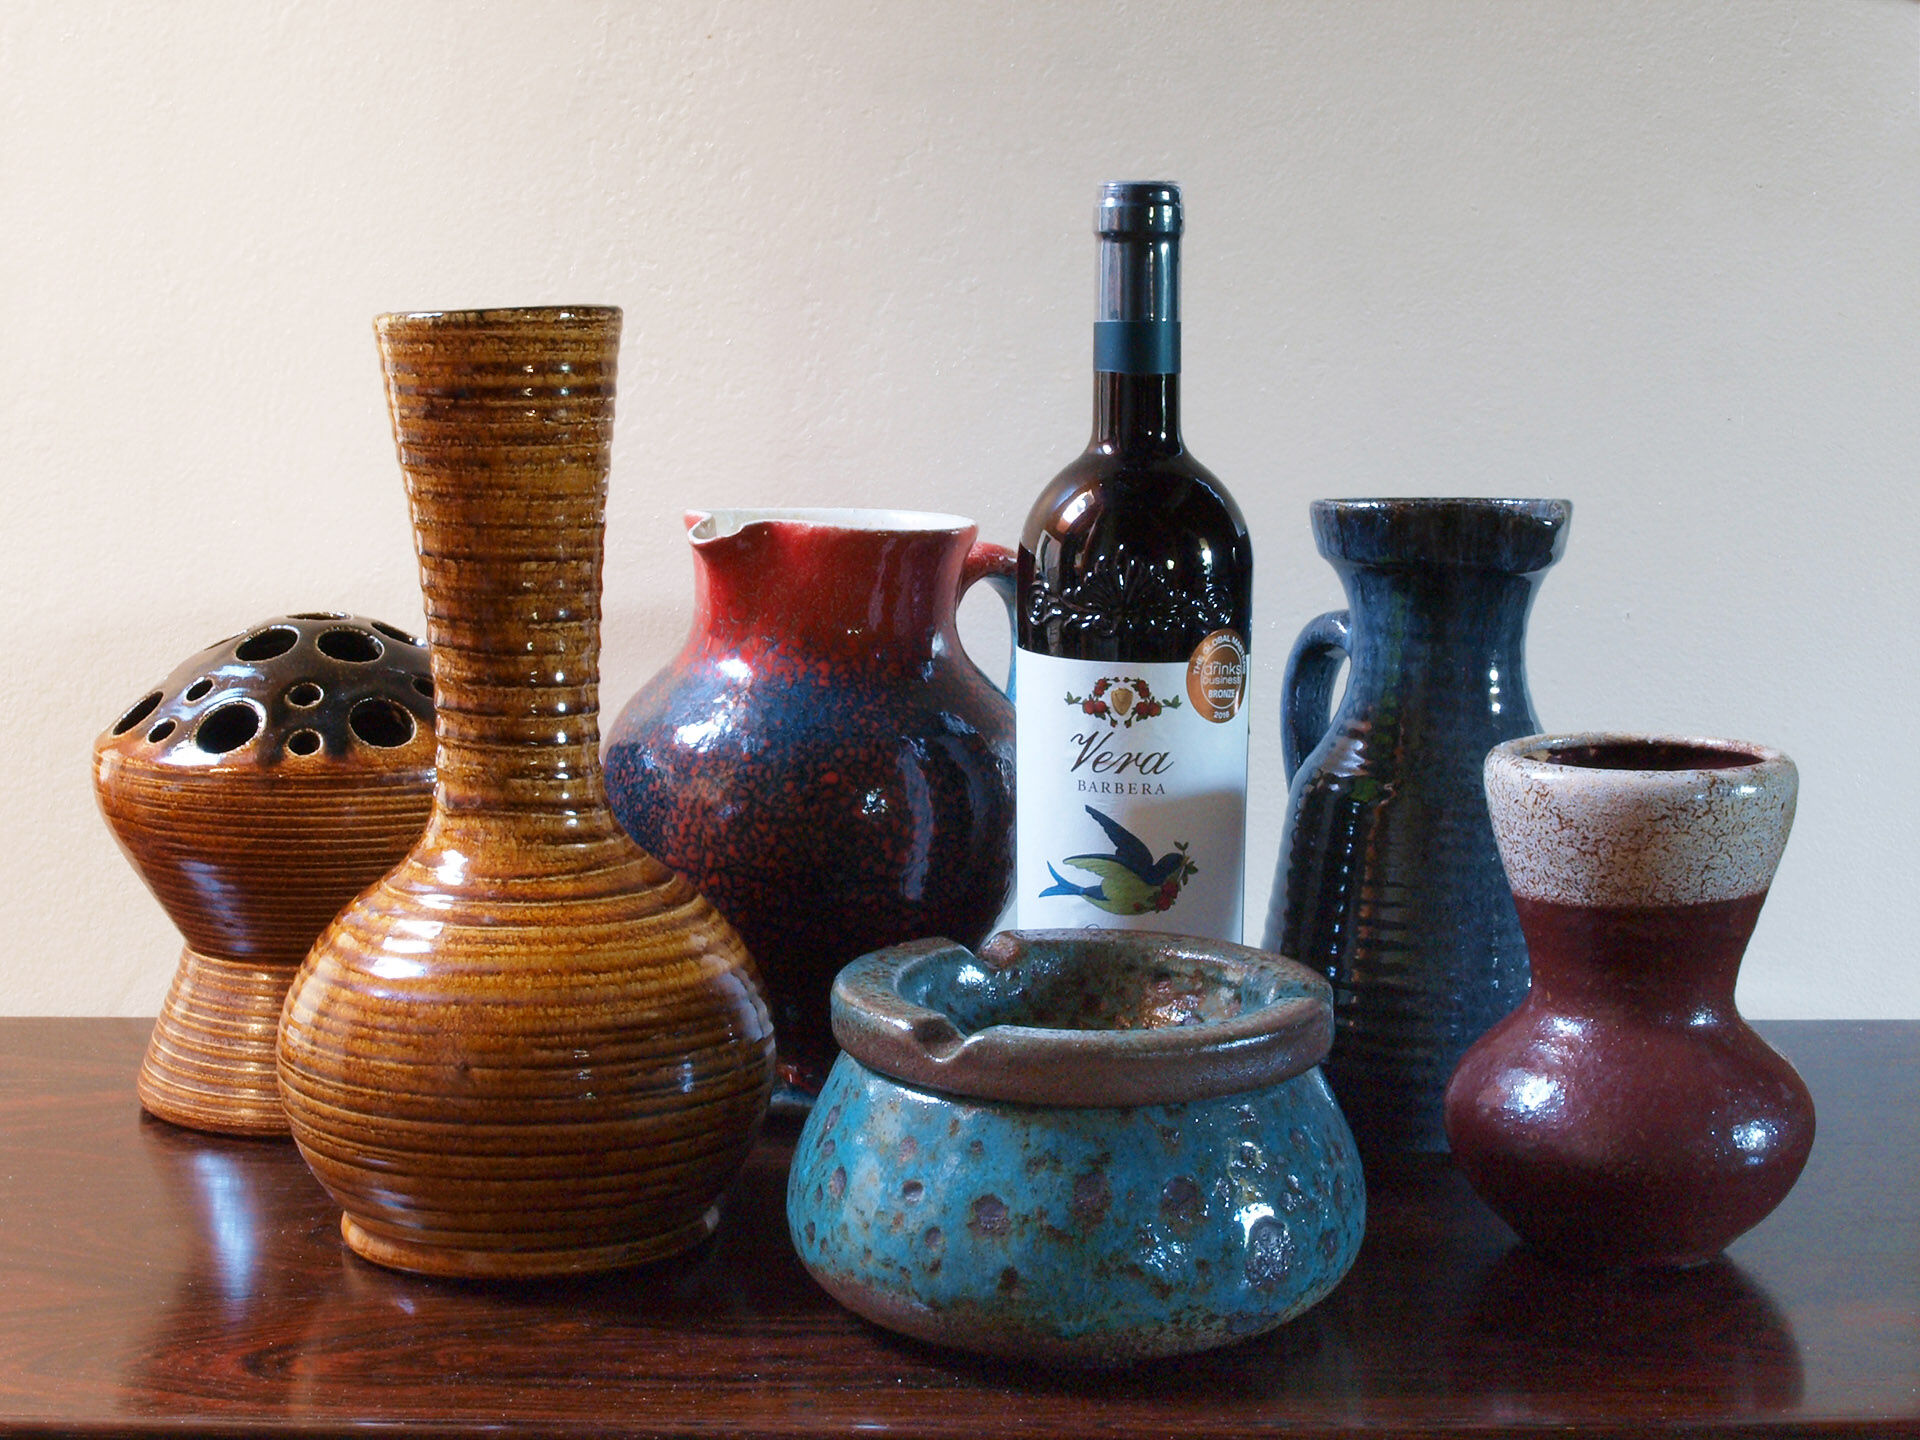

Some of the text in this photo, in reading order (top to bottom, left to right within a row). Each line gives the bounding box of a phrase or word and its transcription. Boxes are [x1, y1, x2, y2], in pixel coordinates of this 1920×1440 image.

[1193, 655, 1204, 675] THE
[1203, 634, 1230, 654] GLOBAL
[1204, 661, 1241, 675] drinks
[1203, 676, 1240, 685] business
[1208, 689, 1235, 699] BRONZE
[1070, 730, 1174, 775] Vera
[1078, 779, 1165, 795] BARBERA
